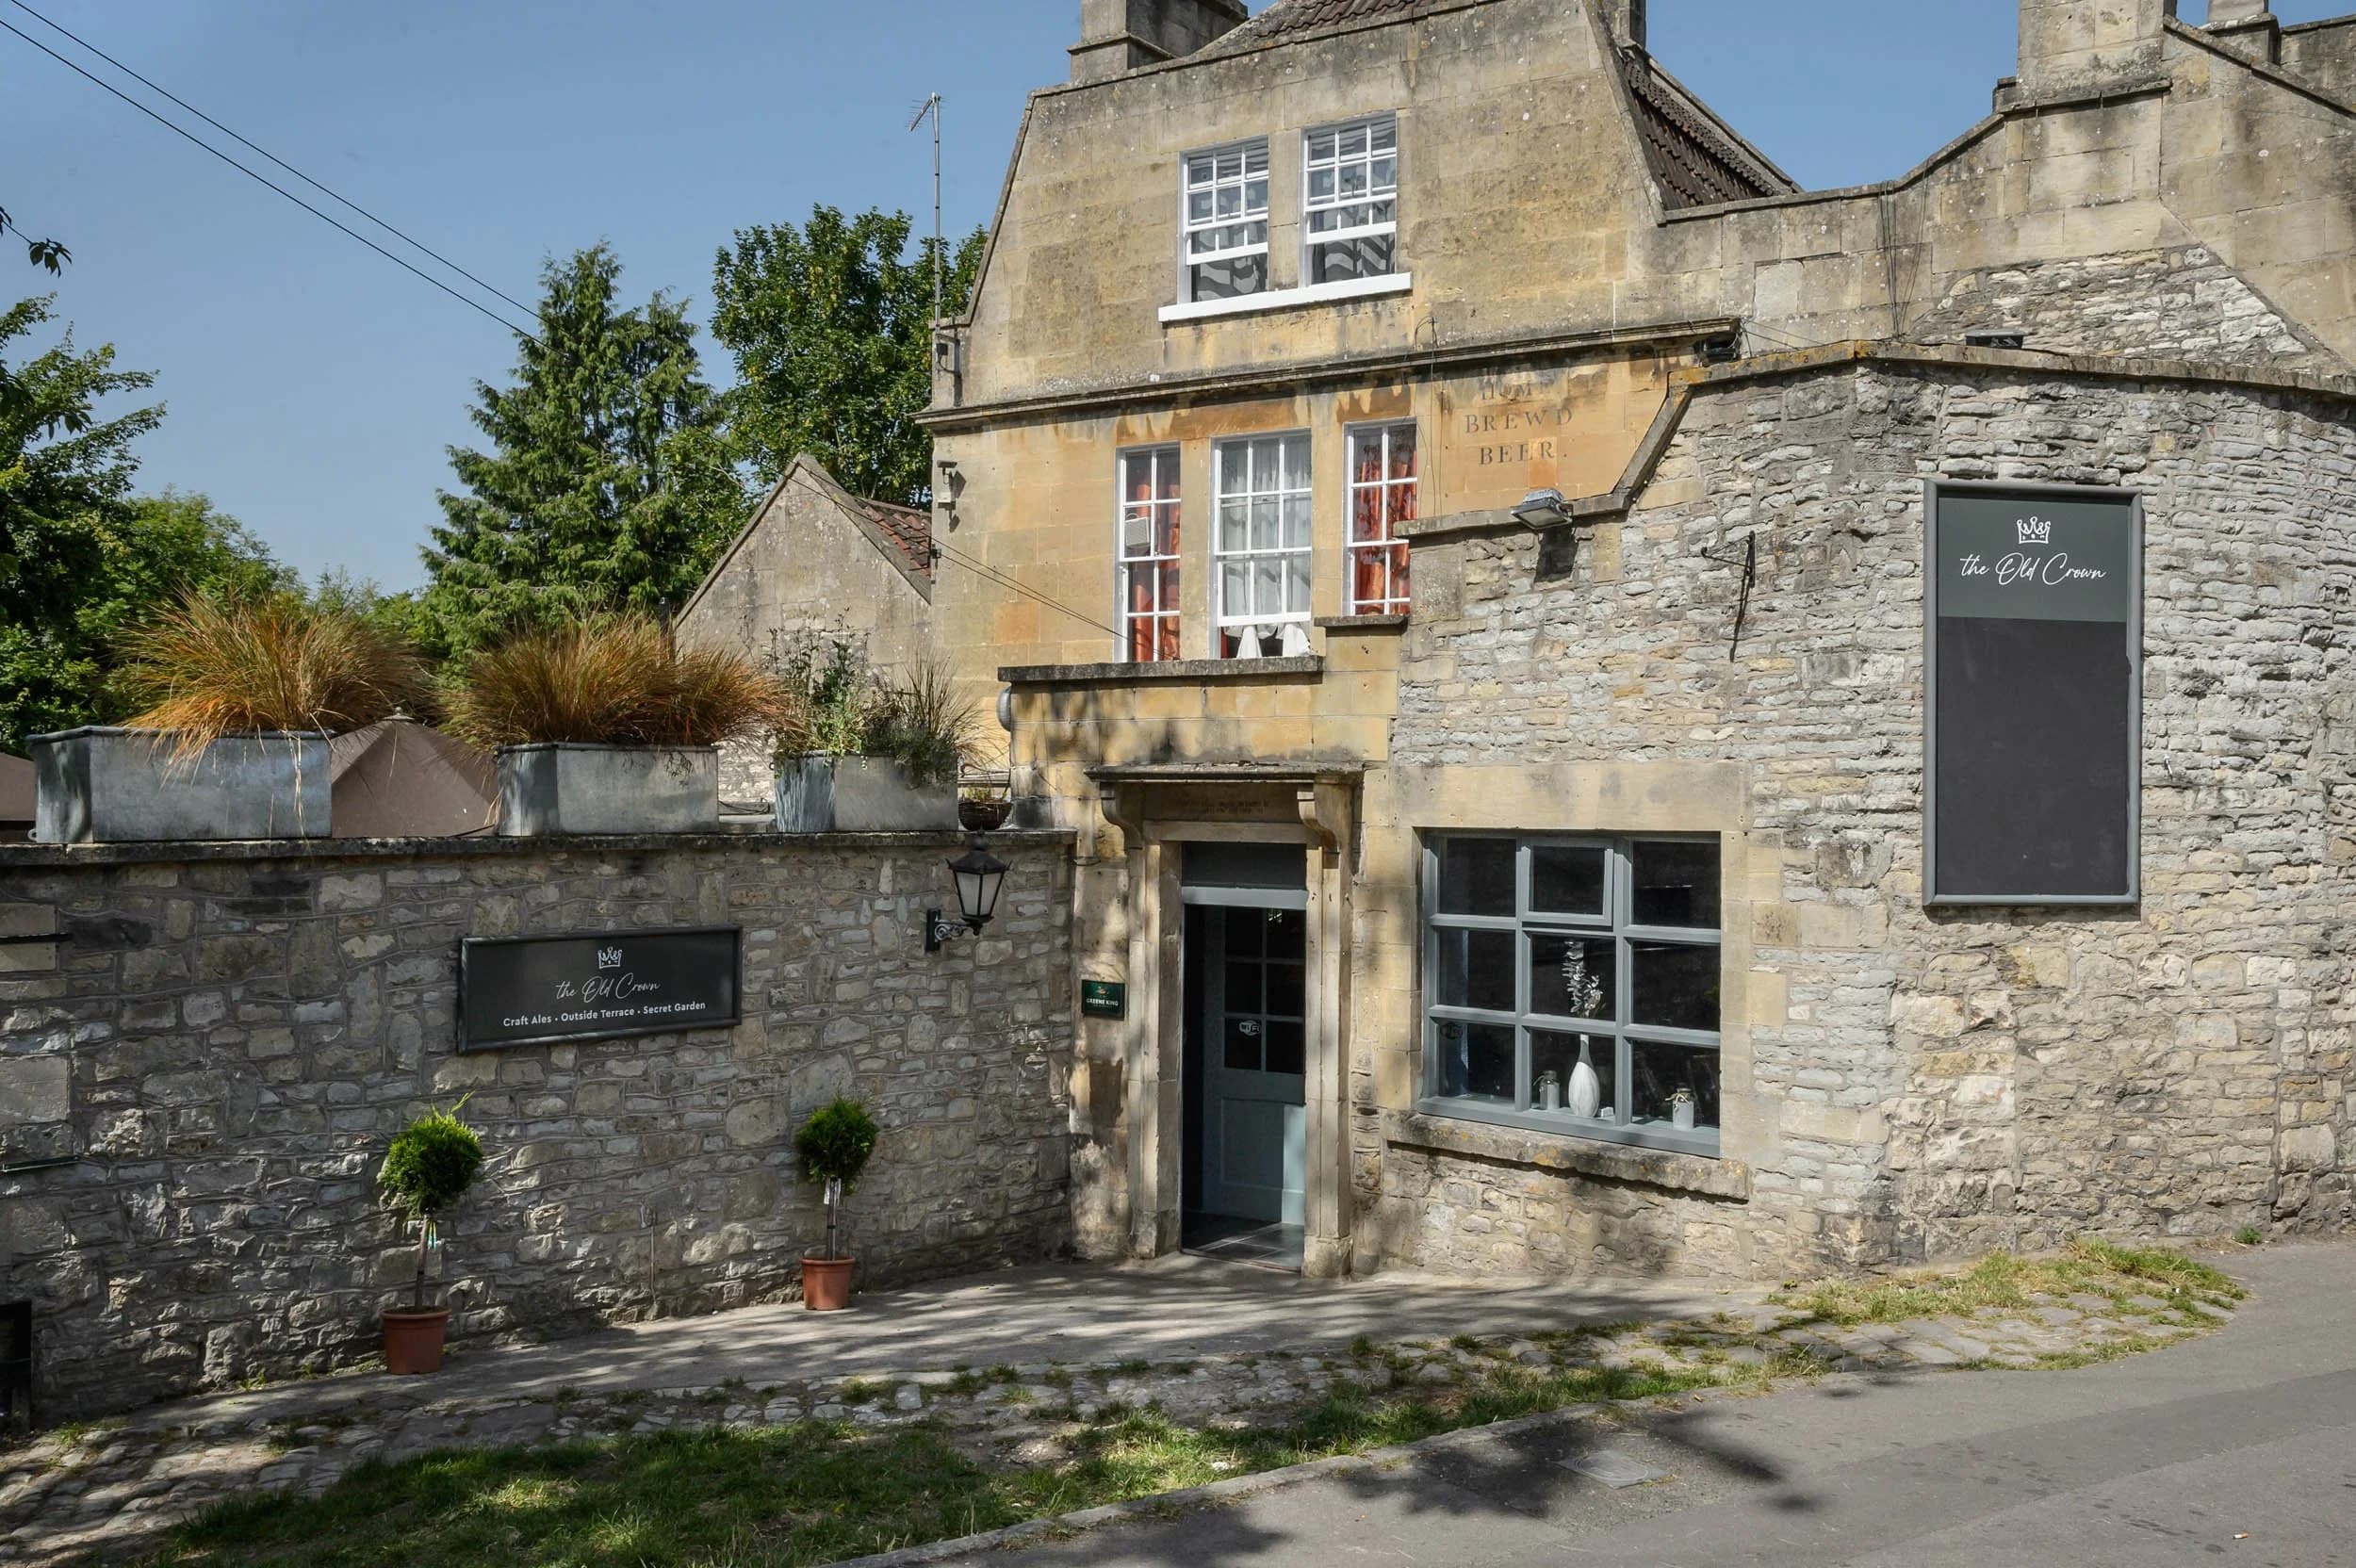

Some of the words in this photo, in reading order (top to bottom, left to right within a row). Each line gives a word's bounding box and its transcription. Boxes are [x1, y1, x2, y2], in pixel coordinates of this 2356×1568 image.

[1960, 553, 1990, 577] the
[1995, 552, 2040, 585] Old
[2042, 552, 2106, 585] Crown
[555, 979, 578, 1001] the
[581, 975, 611, 1004] Old
[615, 972, 661, 999] Crown
[503, 1017, 529, 1027] Craft
[531, 1015, 552, 1025] Ales
[561, 1009, 598, 1022] Outside
[600, 1006, 635, 1019] Terrace
[643, 1004, 672, 1015] Secret
[675, 1001, 707, 1012] Garden
